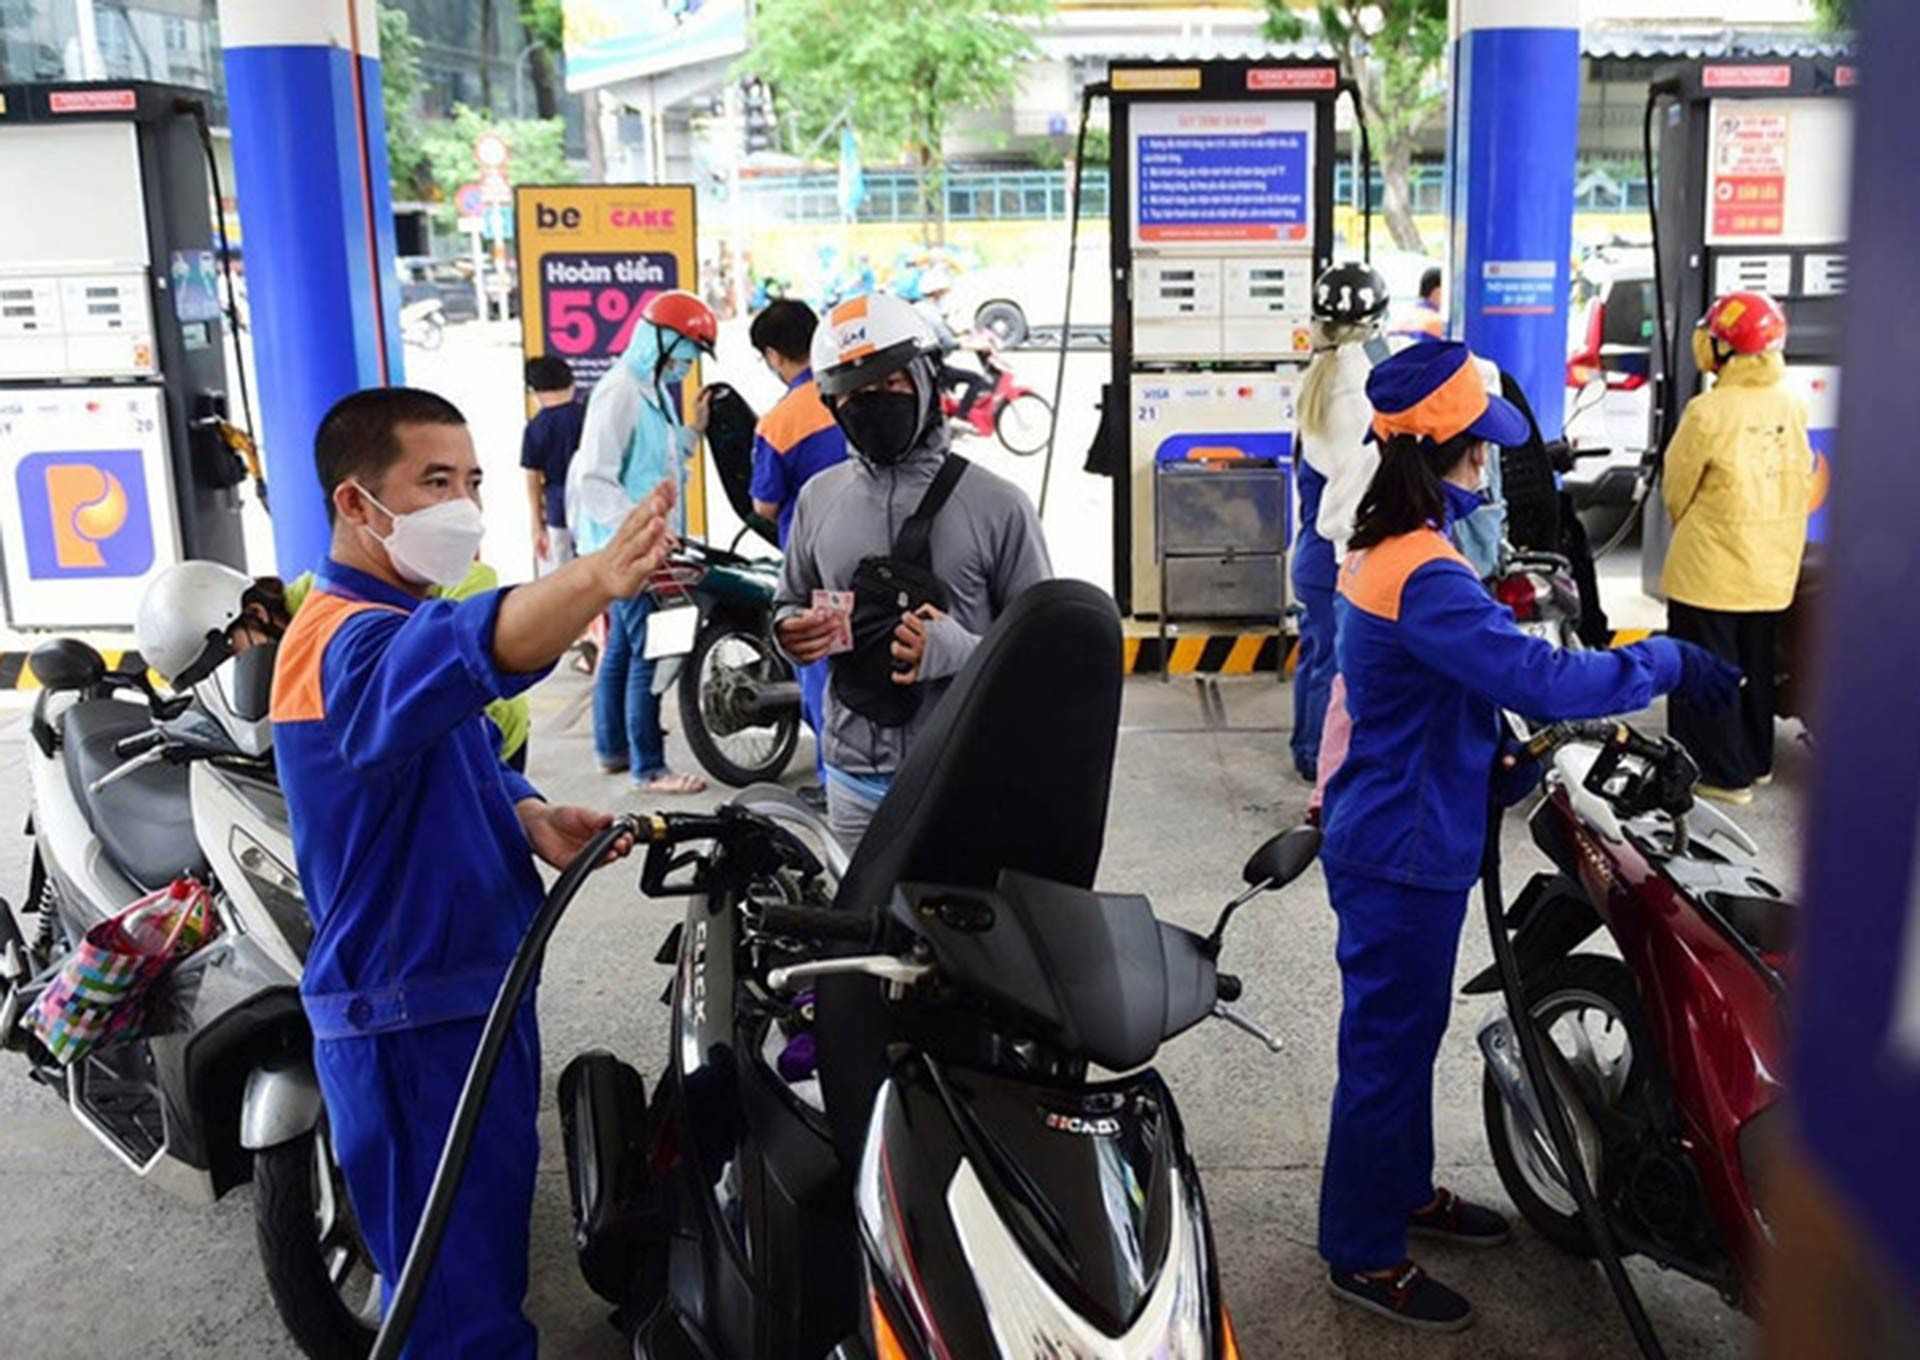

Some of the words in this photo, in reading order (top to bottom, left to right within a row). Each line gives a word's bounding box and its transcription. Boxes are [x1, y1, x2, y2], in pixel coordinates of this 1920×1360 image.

[536, 203, 581, 229] be
[610, 210, 675, 228] CAKE
[546, 259, 612, 283] Hoàn
[548, 287, 662, 354] 5%
